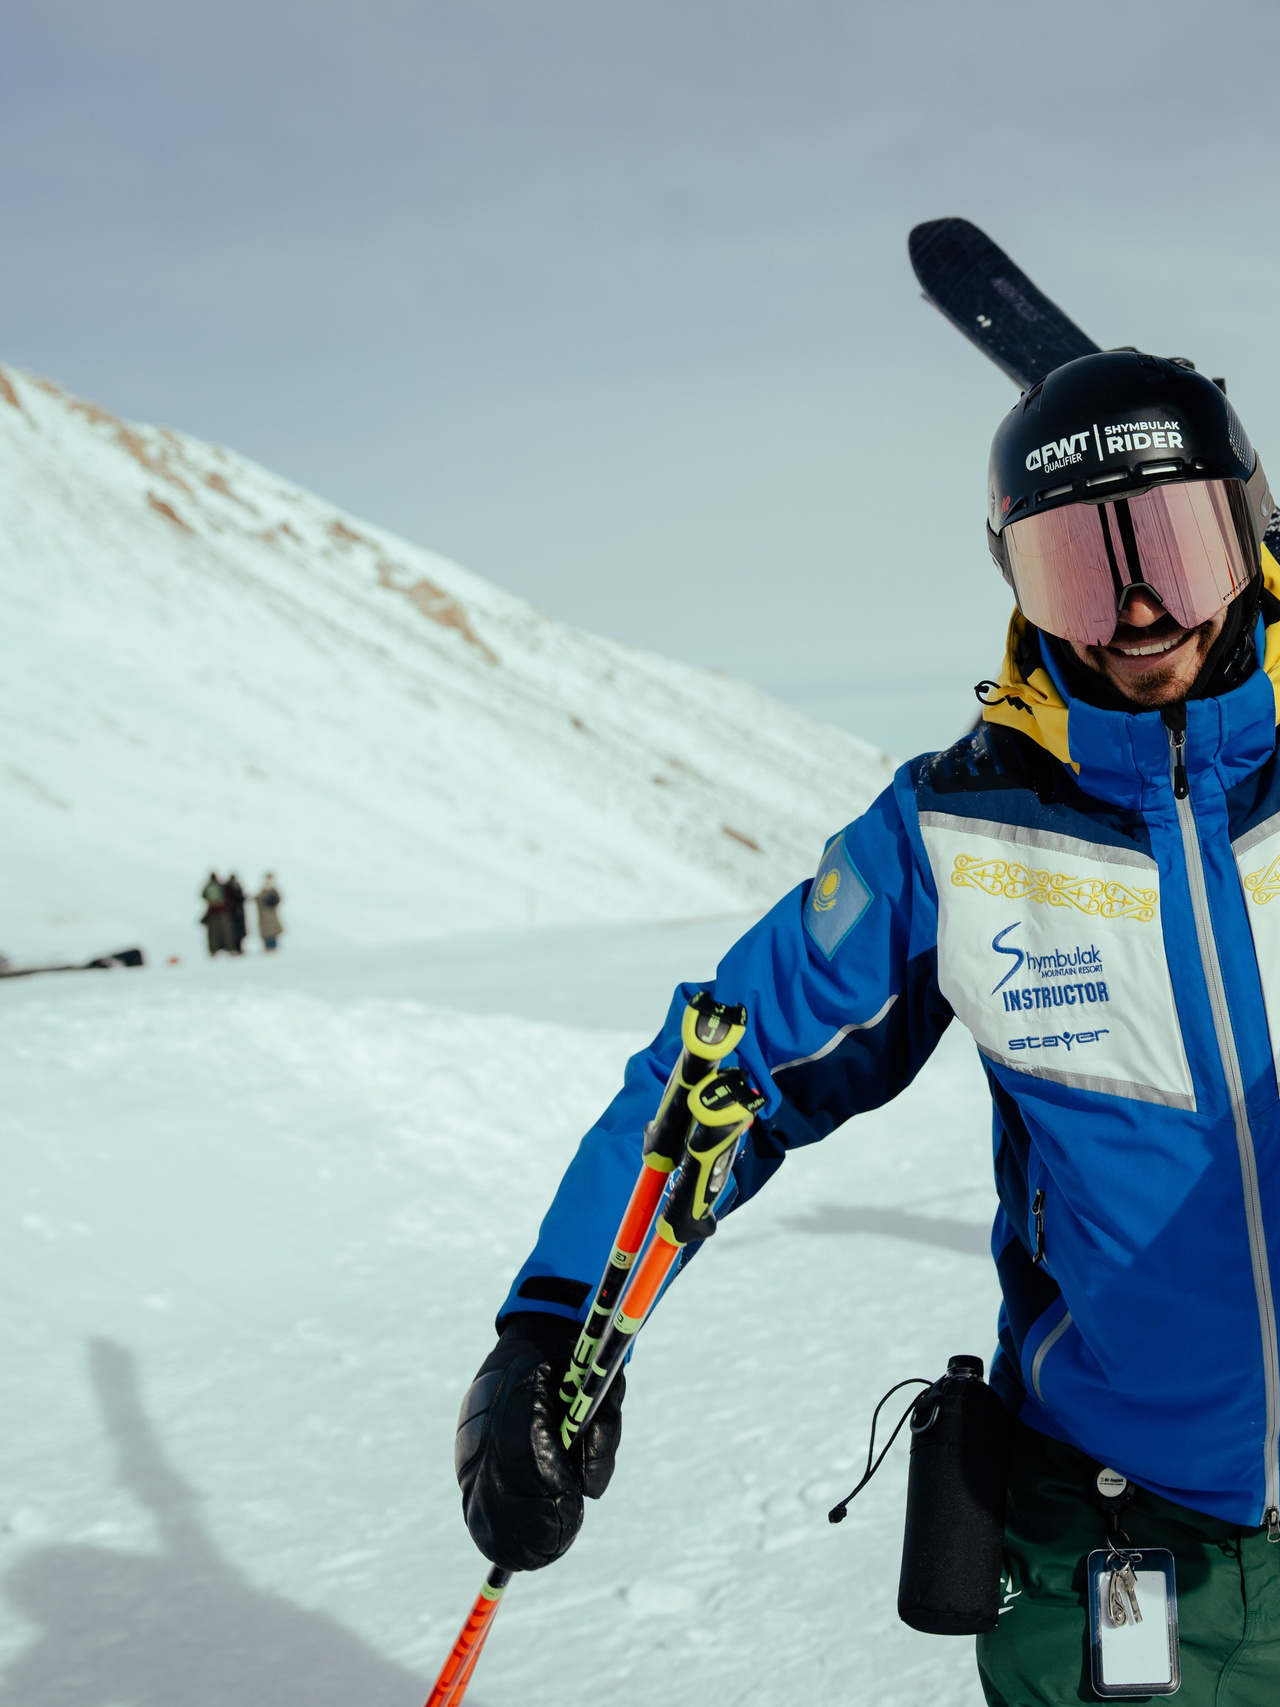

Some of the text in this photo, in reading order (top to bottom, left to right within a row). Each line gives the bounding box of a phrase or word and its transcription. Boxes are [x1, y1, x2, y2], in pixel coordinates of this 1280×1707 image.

[1104, 421, 1180, 435] SHYMBULAK
[1042, 431, 1090, 464] FWT
[1106, 432, 1184, 454] RIDER
[1044, 453, 1083, 473] QUALIFIER
[991, 921, 1102, 995] Shymbulak
[1041, 964, 1103, 979] MOUNTAIN RESORT
[1003, 981, 1110, 1011] INSTRUCTOR
[1008, 1029, 1110, 1051] stayer
